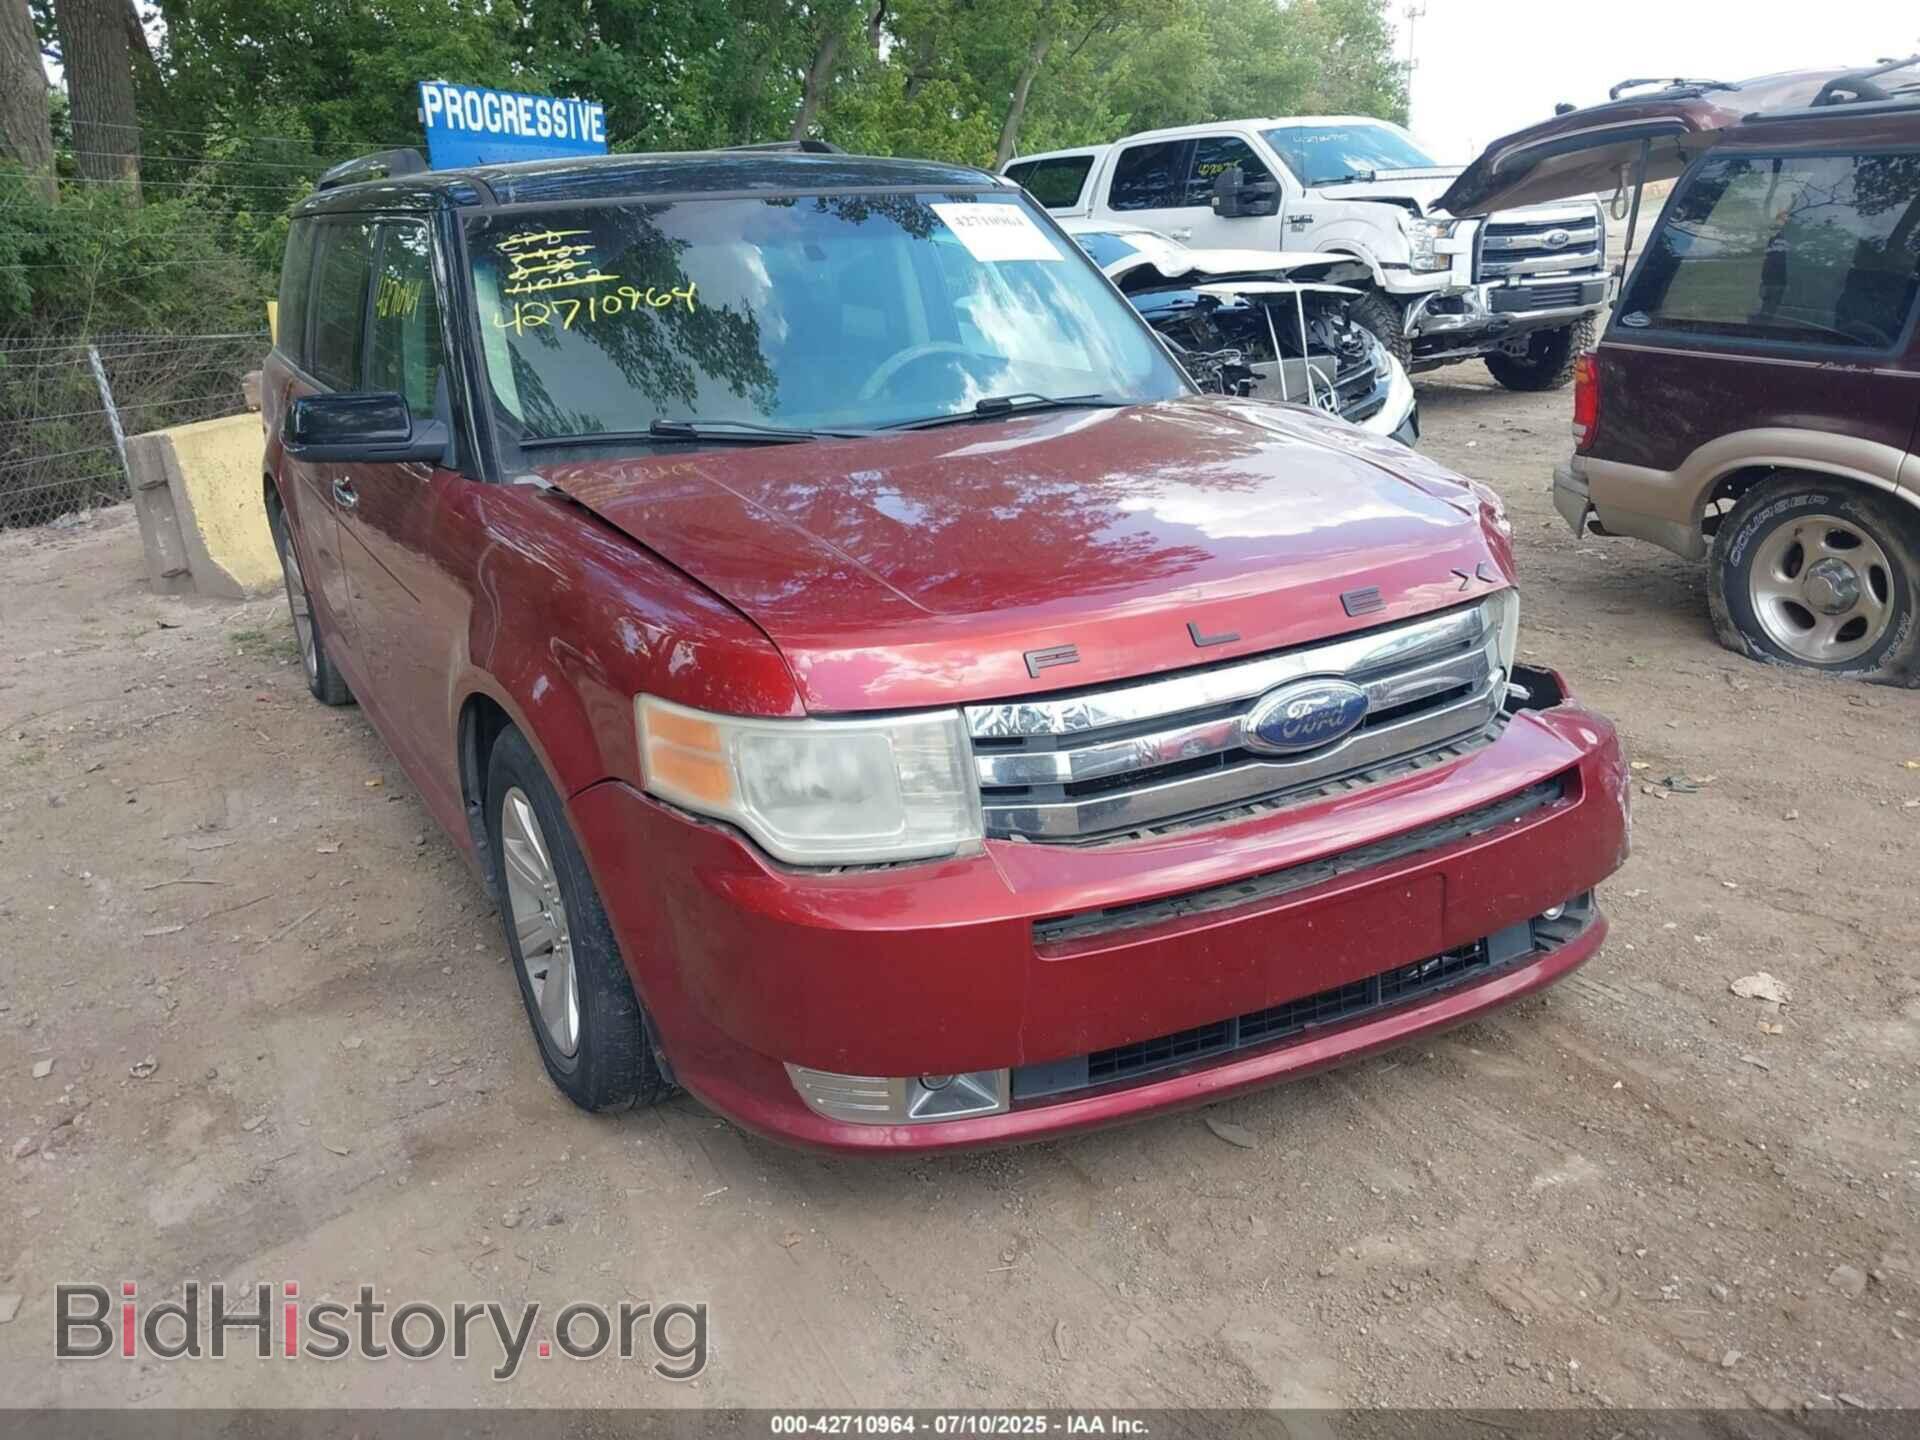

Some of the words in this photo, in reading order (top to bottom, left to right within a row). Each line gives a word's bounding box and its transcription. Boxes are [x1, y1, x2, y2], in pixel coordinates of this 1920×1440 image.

[422, 86, 606, 143] PROGRESSIVE
[493, 281, 697, 337] 42710964
[1022, 560, 1500, 680] FLEX
[1282, 695, 1346, 739] Ford
